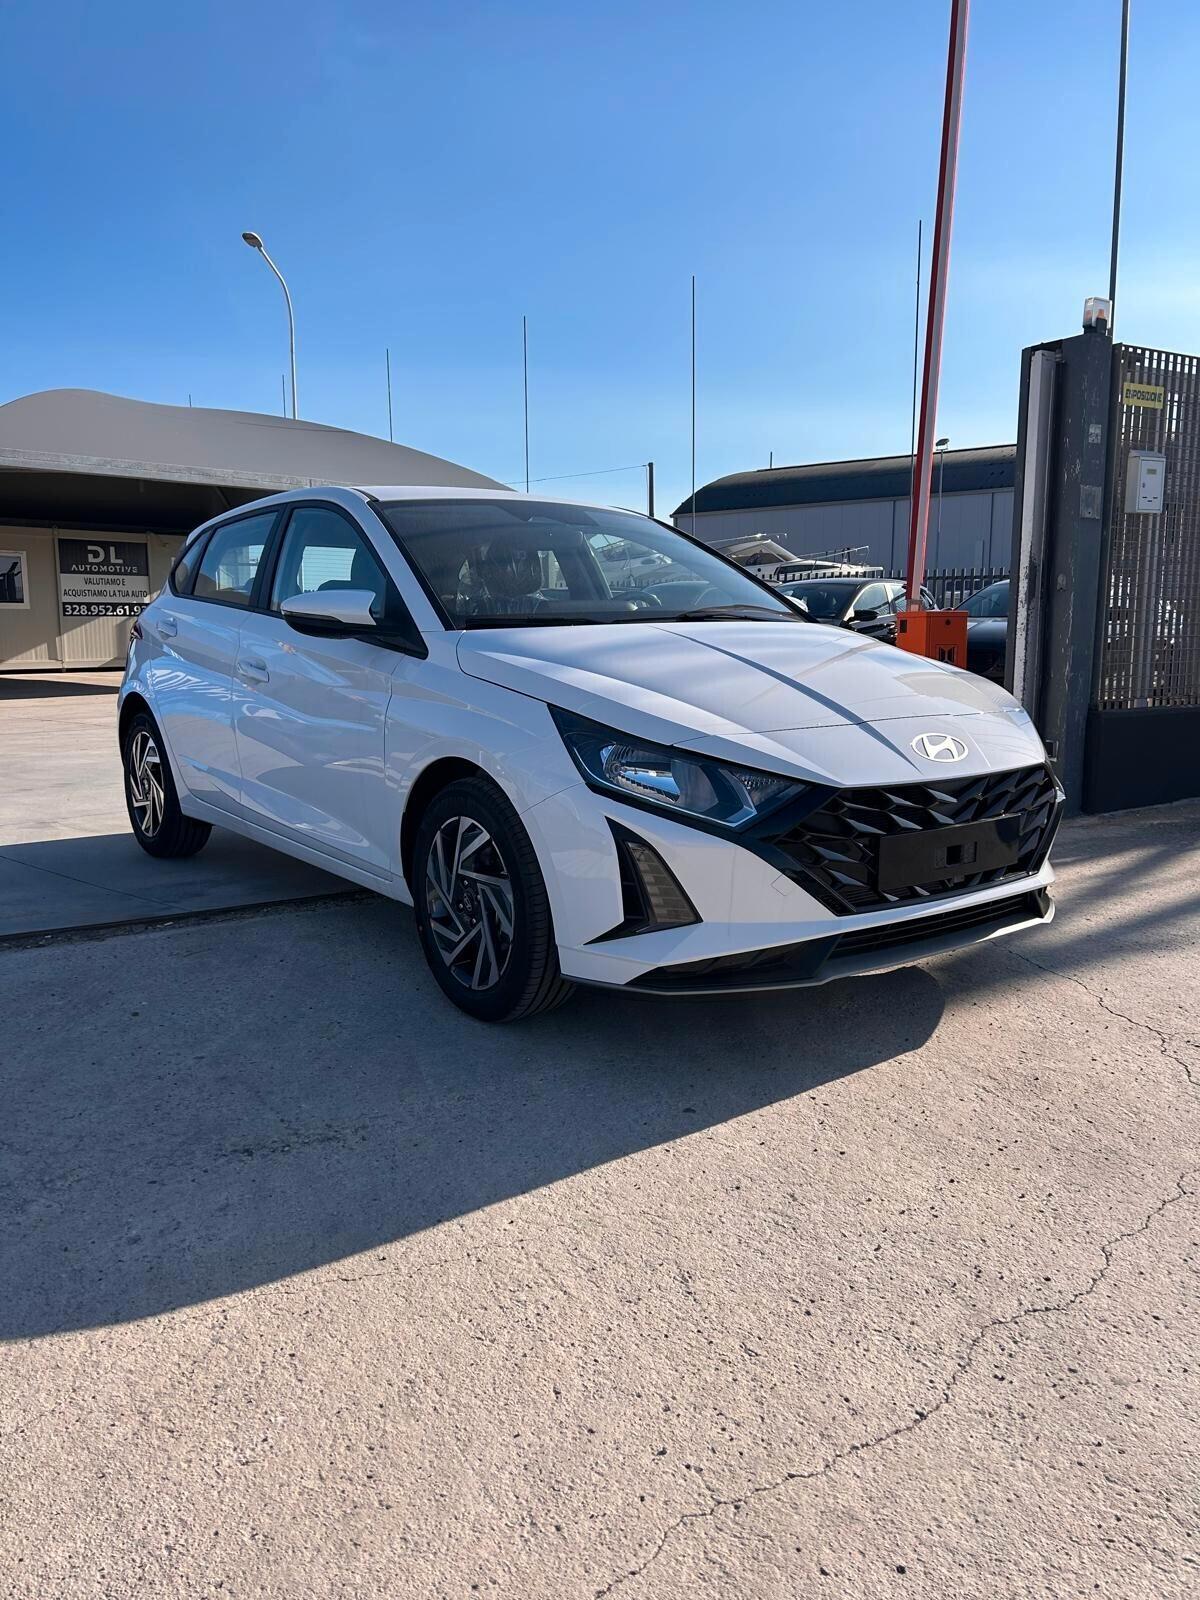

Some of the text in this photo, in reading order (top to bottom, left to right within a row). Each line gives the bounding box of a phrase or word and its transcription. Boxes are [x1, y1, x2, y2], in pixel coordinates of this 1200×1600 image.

[87, 545, 124, 564] DL
[71, 564, 138, 573] AUTOMOTIVE
[83, 577, 126, 586] VALUTIAMO E
[63, 588, 148, 598] ACQUISTIAMO LA TUA AUTO
